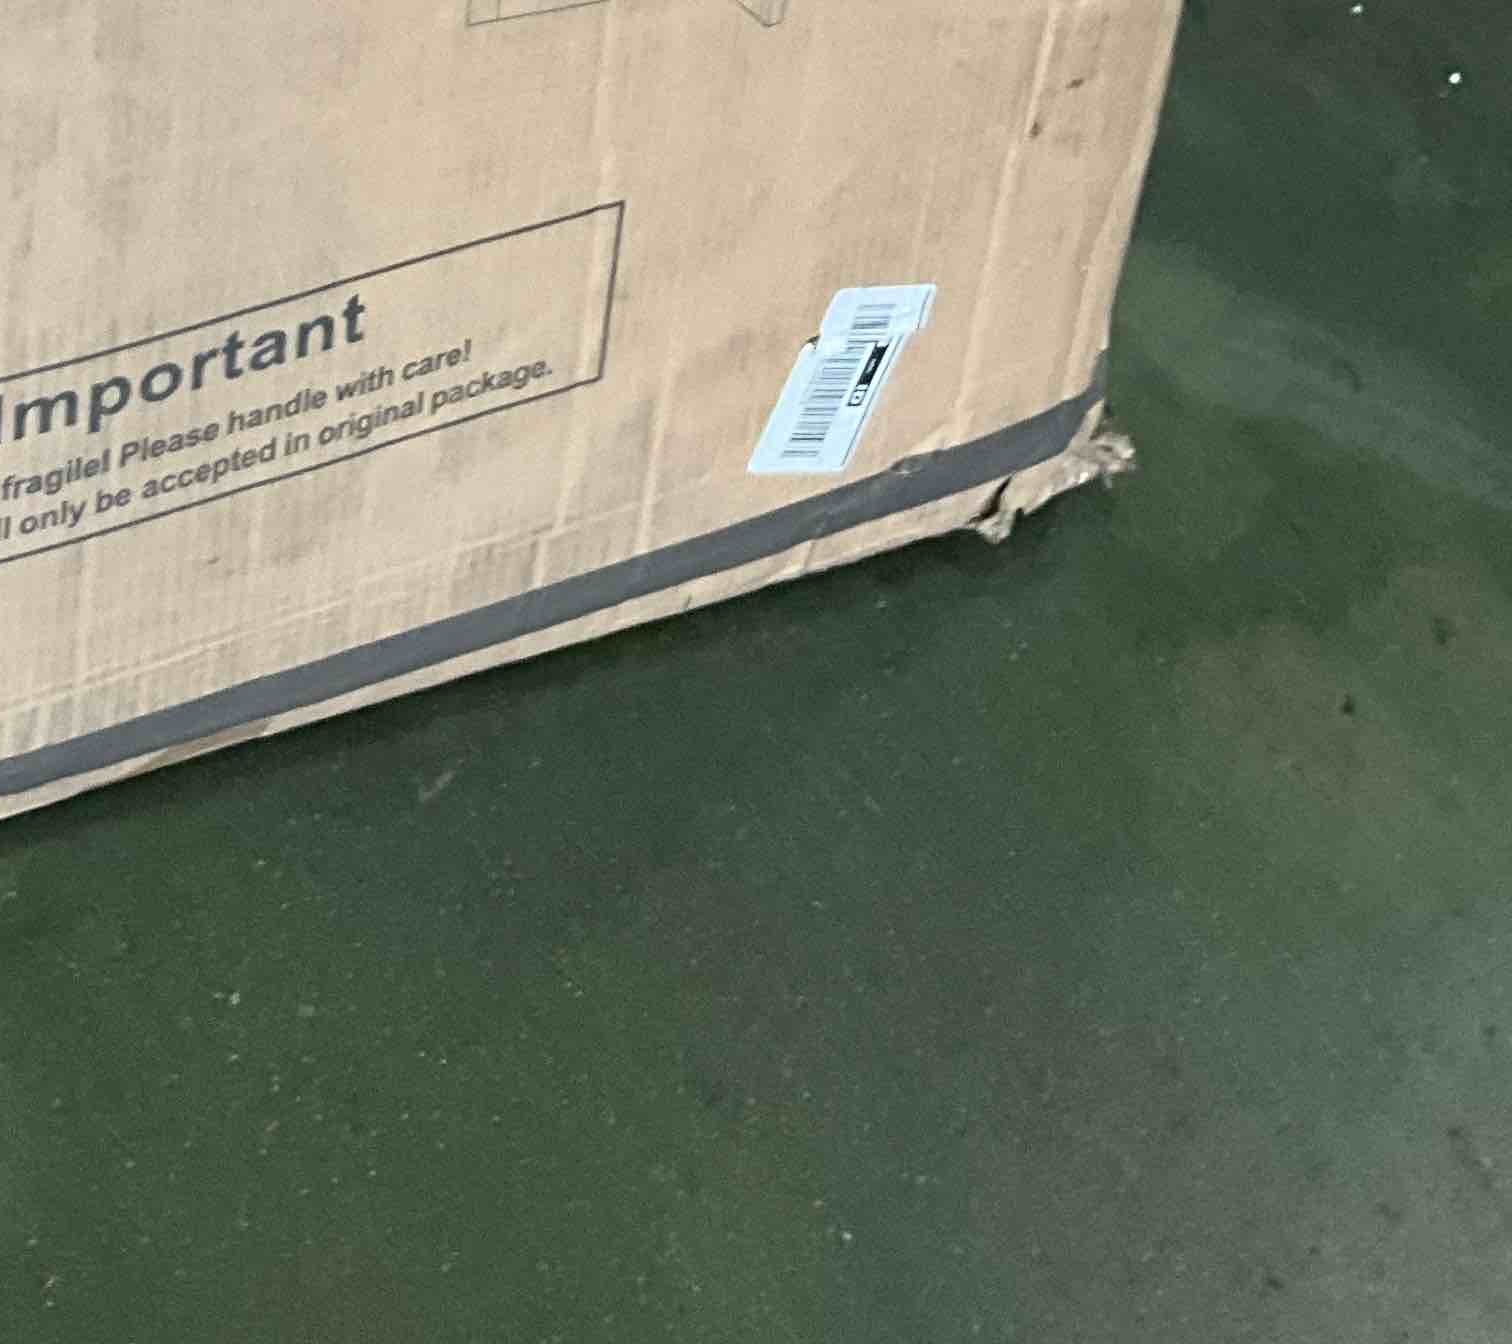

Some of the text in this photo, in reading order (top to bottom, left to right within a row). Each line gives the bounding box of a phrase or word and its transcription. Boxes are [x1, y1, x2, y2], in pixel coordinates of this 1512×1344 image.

[0, 448, 112, 504] fragile!
[118, 422, 219, 469] Please
[226, 387, 327, 435] handle
[335, 365, 395, 403] with
[401, 339, 473, 382] care!
[19, 496, 86, 539] only
[94, 483, 132, 515] be
[141, 437, 277, 499] accepted
[284, 427, 310, 456] in
[318, 392, 424, 448] original
[429, 358, 553, 418] package.
